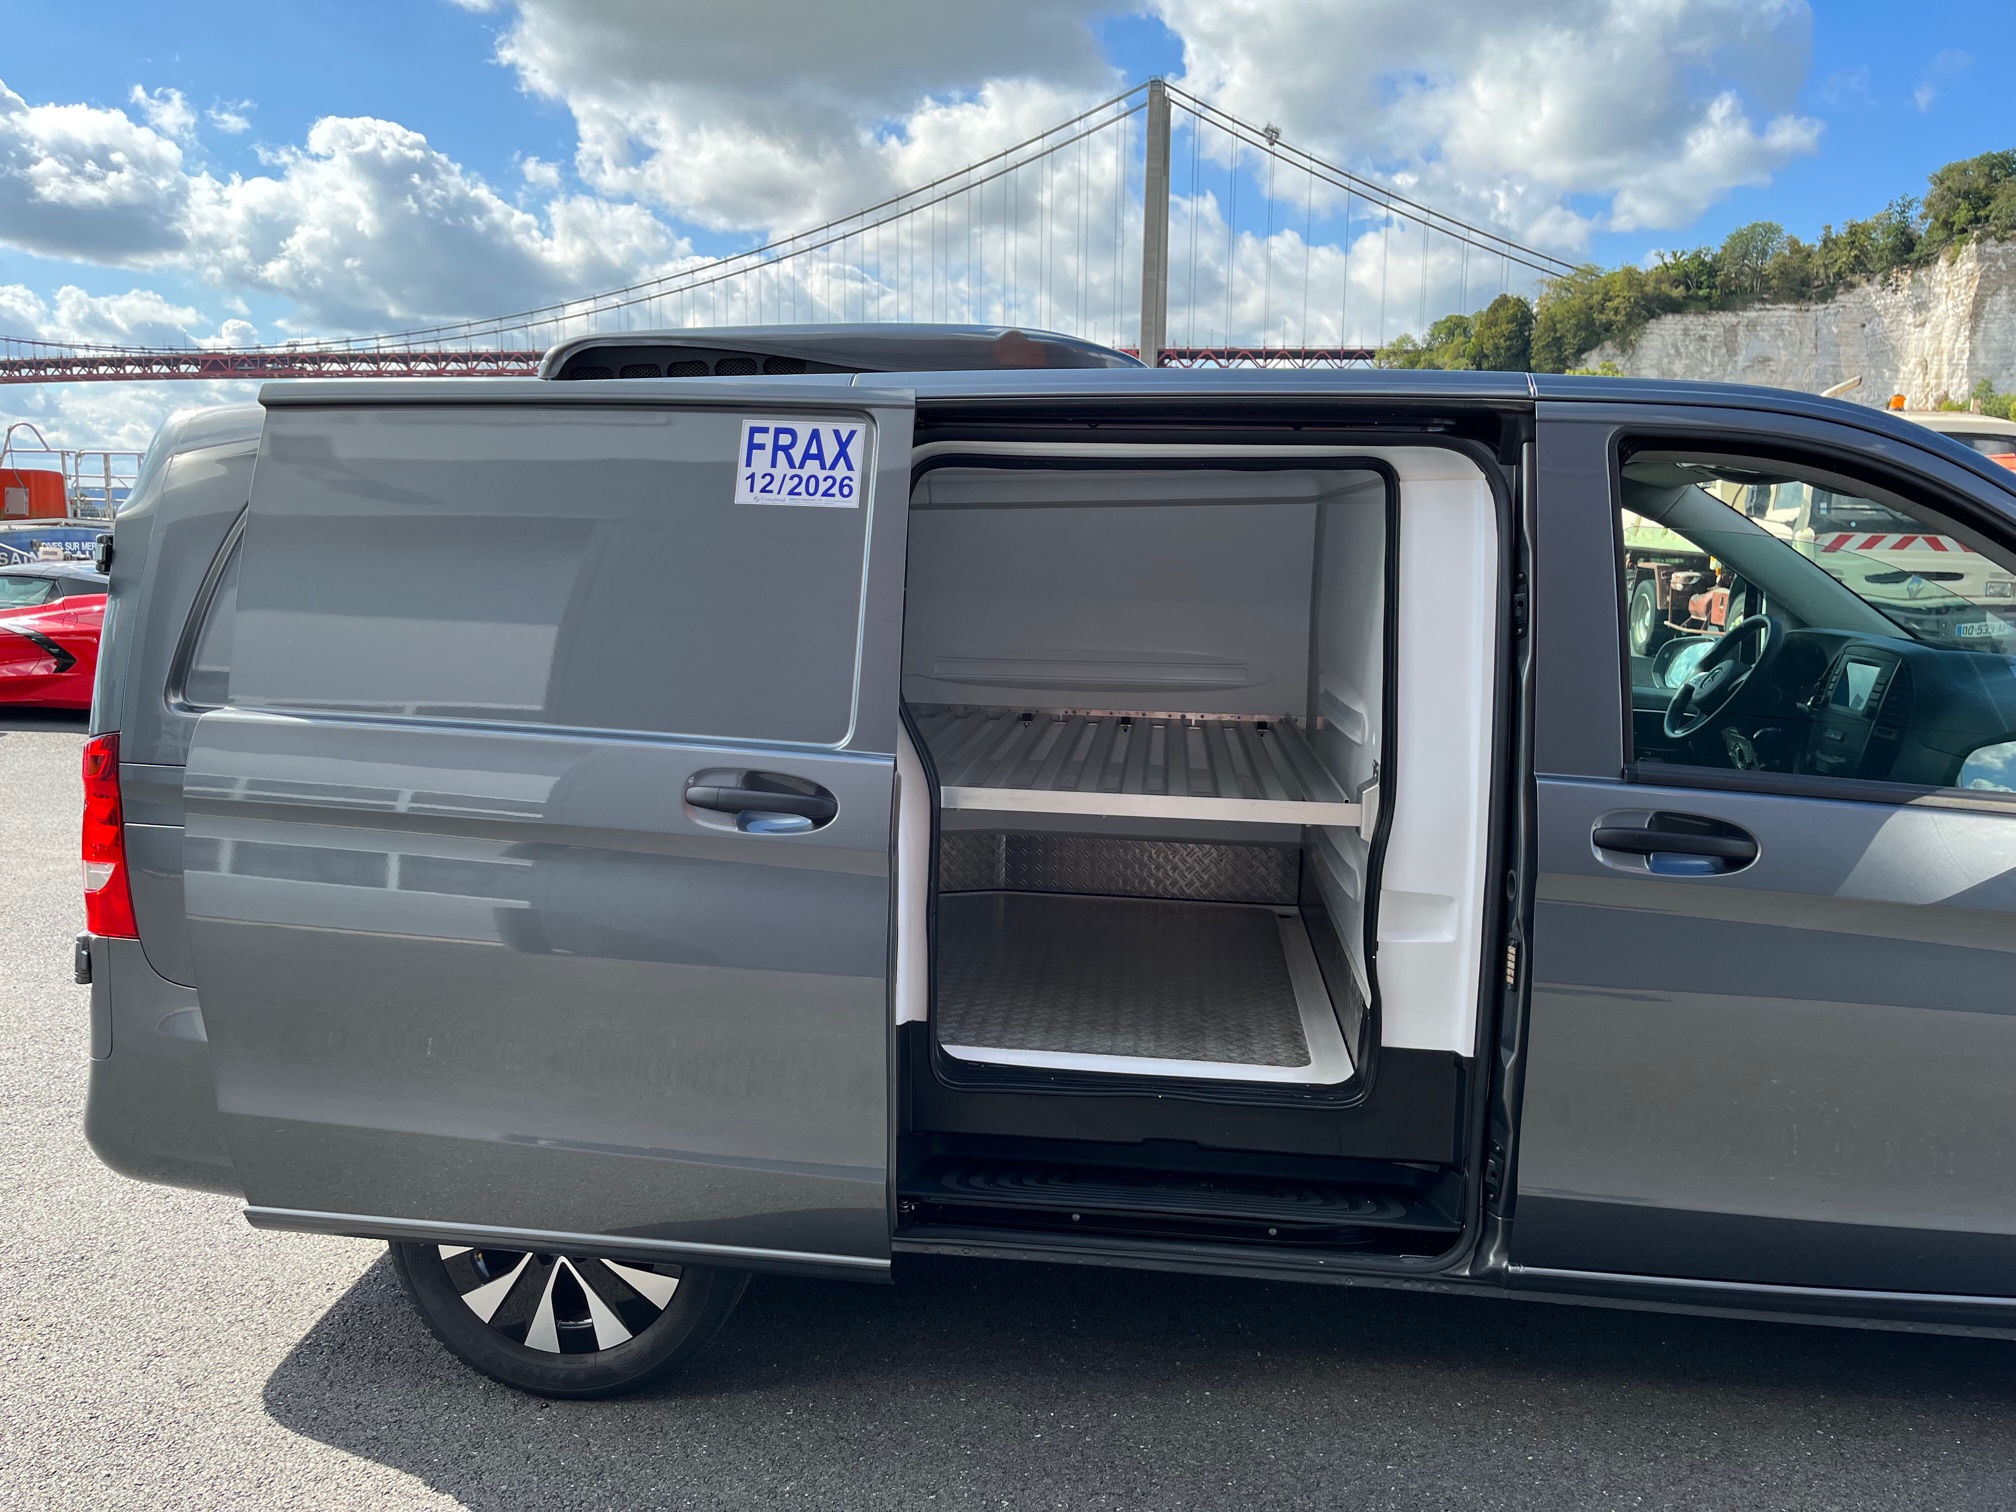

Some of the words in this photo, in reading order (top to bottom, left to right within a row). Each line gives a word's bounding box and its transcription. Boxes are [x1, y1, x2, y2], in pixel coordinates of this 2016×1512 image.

[745, 426, 857, 471] FRAX
[745, 472, 854, 498] 12/2026
[65, 541, 80, 550] SUR
[81, 541, 96, 550] MER
[0, 551, 40, 565] SAIN
